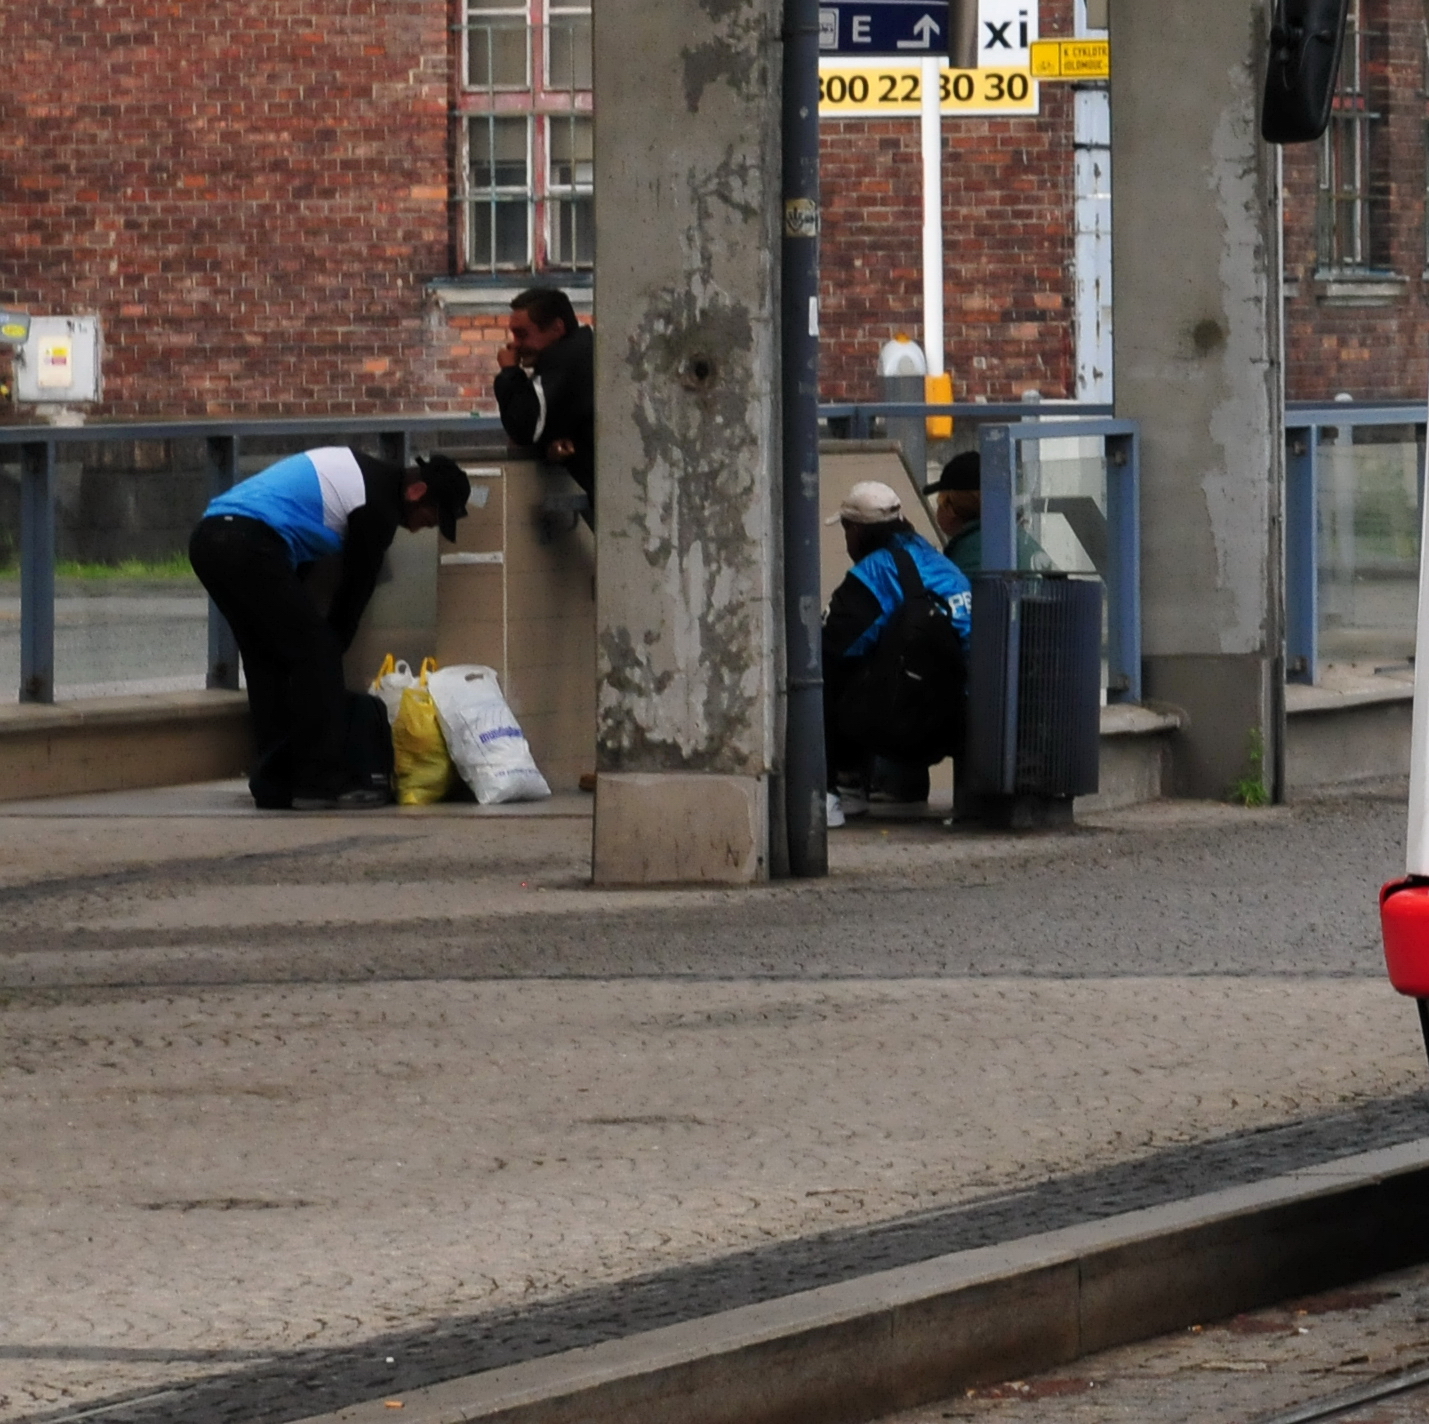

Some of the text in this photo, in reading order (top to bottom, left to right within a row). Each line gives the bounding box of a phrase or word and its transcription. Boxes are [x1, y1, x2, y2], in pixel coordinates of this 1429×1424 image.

[852, 15, 871, 43] E
[818, 75, 869, 103] 00
[878, 75, 921, 102] 22
[984, 74, 1029, 102] 30
